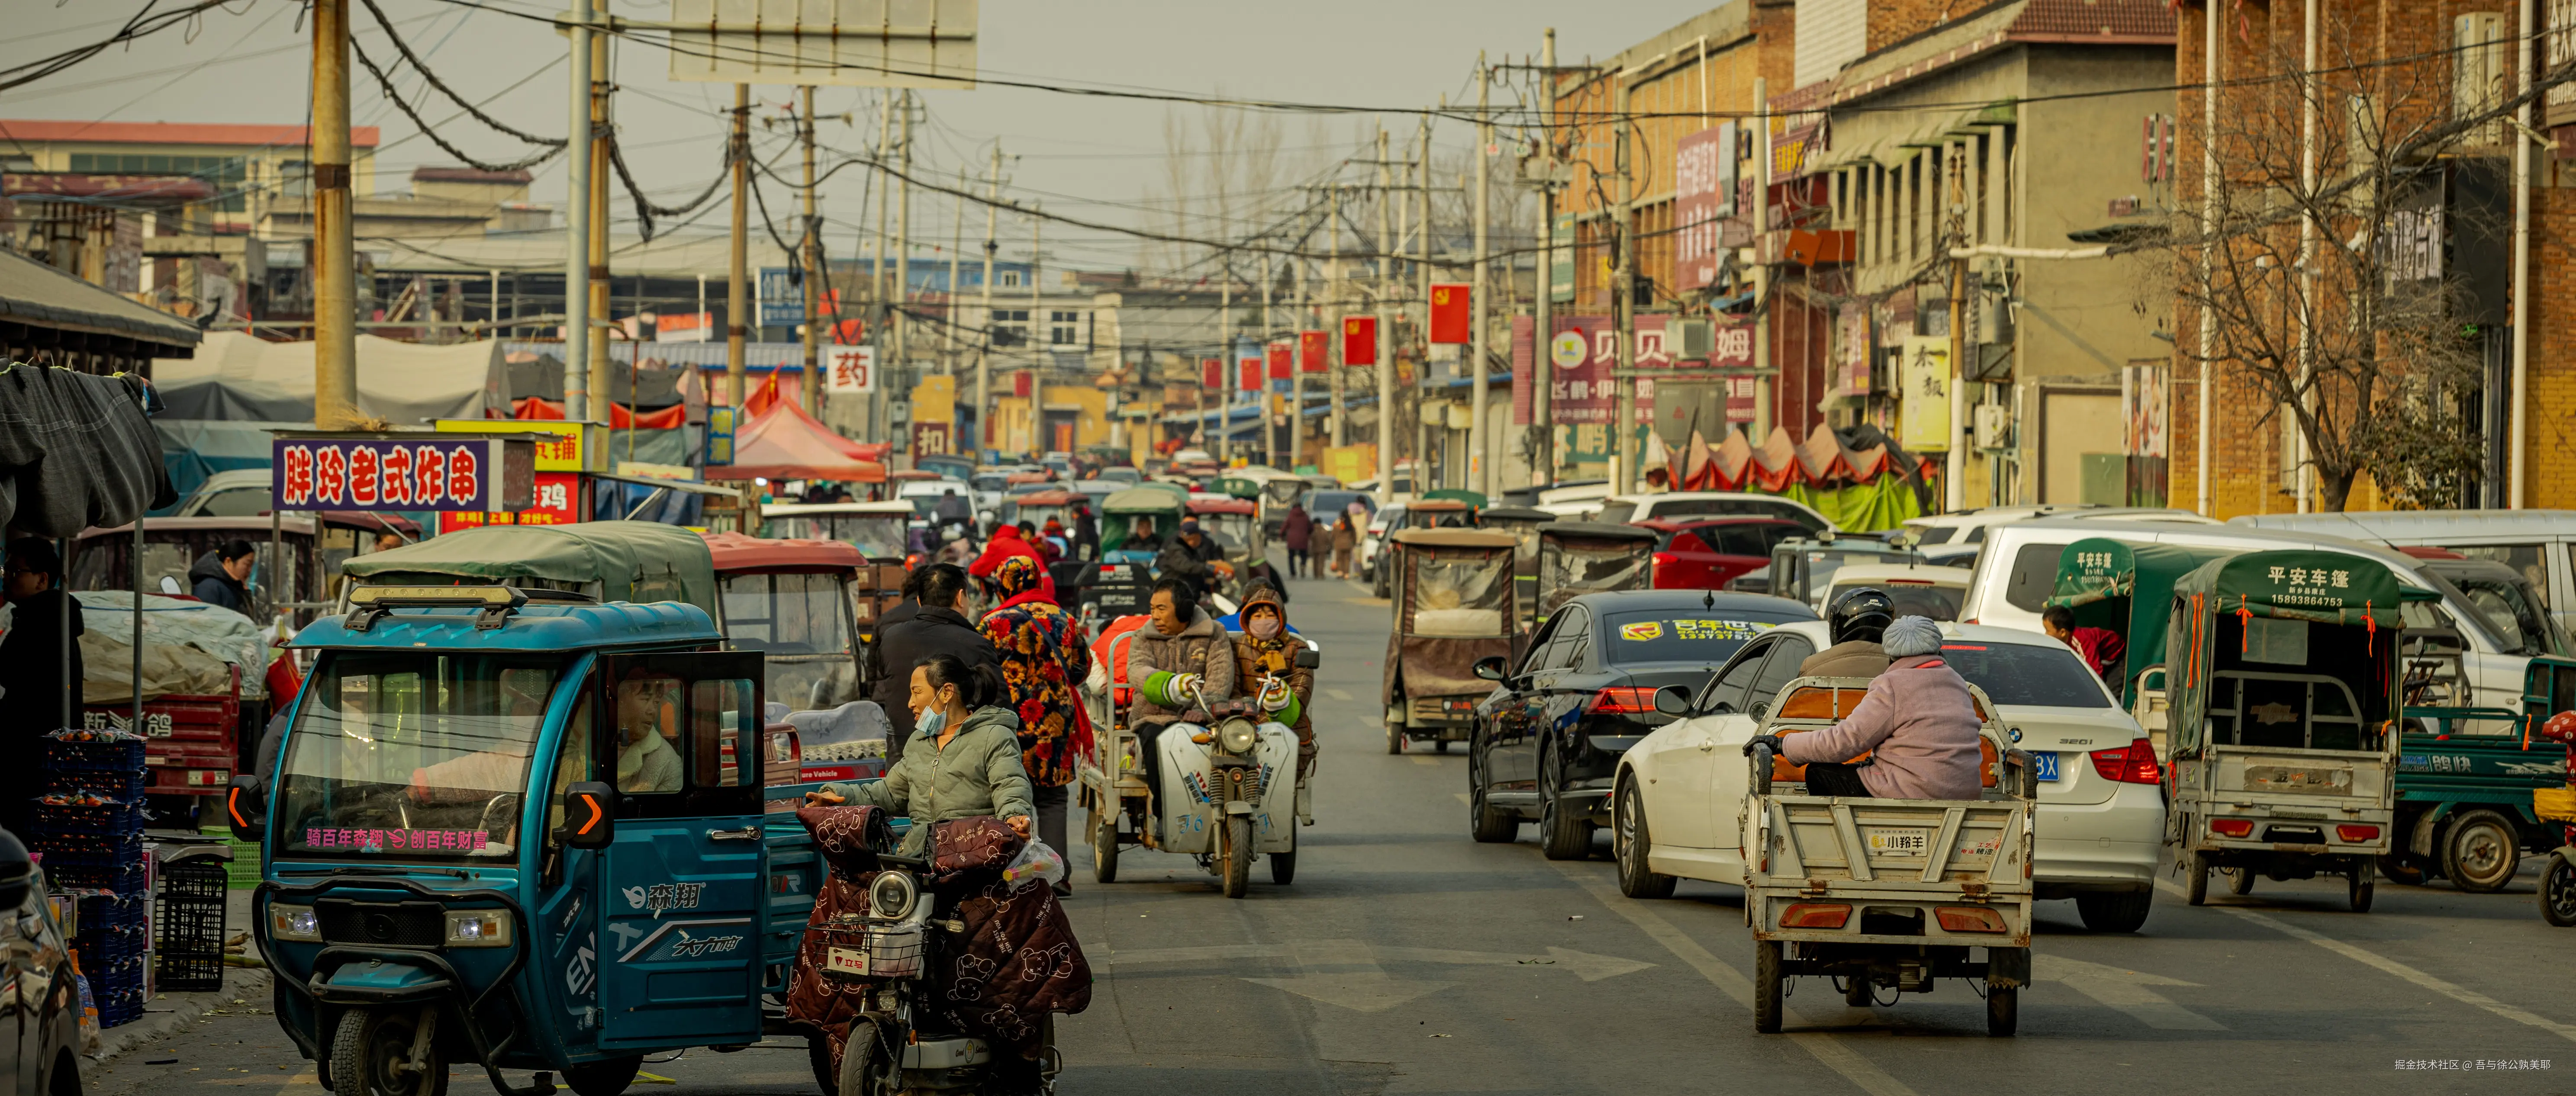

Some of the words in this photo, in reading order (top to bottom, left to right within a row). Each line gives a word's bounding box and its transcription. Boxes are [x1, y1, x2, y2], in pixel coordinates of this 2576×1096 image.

[1594, 328, 1750, 364] 贝贝姆
[835, 352, 869, 388] 药
[918, 427, 944, 456] 扣
[283, 445, 478, 506] 胖玲老式炸串
[2077, 552, 2112, 569] 平安车篷
[2268, 566, 2349, 588] 平安车篷
[2272, 594, 2343, 607] 15893864753
[147, 714, 172, 736] 鸽
[306, 828, 384, 848] 骑百年森翔
[410, 829, 488, 850] 创百年财富
[955, 834, 965, 842] YOU
[964, 833, 976, 842] BEST
[1887, 836, 1923, 849] 小羚羊
[646, 883, 701, 910] 森翔
[1036, 910, 1044, 919] THE
[672, 935, 743, 957] 大力神
[993, 930, 1001, 942] BEST
[845, 959, 863, 969] 立马
